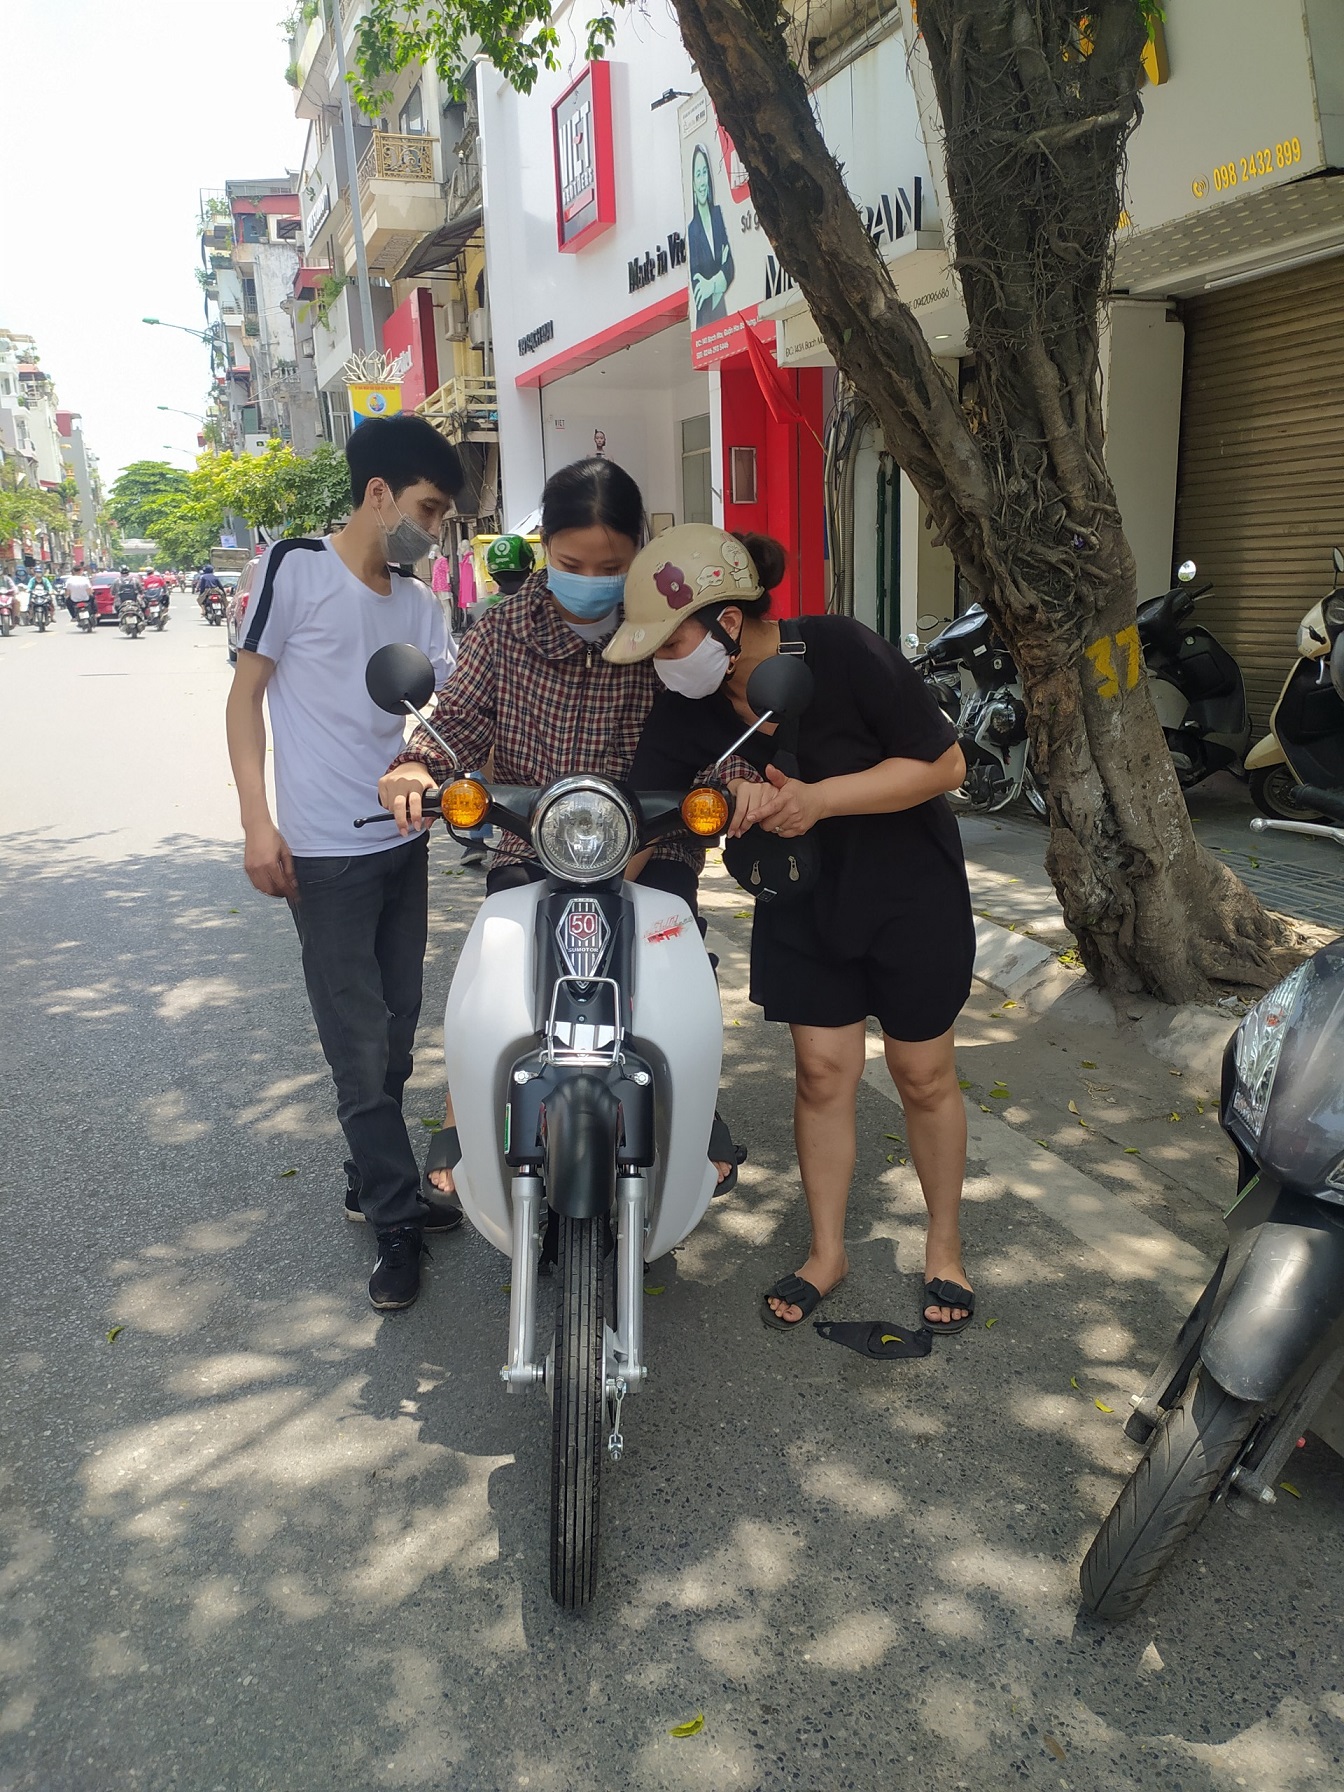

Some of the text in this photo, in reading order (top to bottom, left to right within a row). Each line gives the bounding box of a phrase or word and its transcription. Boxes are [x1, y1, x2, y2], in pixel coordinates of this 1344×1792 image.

[1213, 136, 1302, 192] 098 2432 899
[627, 250, 656, 294] Made
[656, 244, 668, 277] in
[1084, 623, 1140, 699] 37
[571, 915, 595, 934] 50
